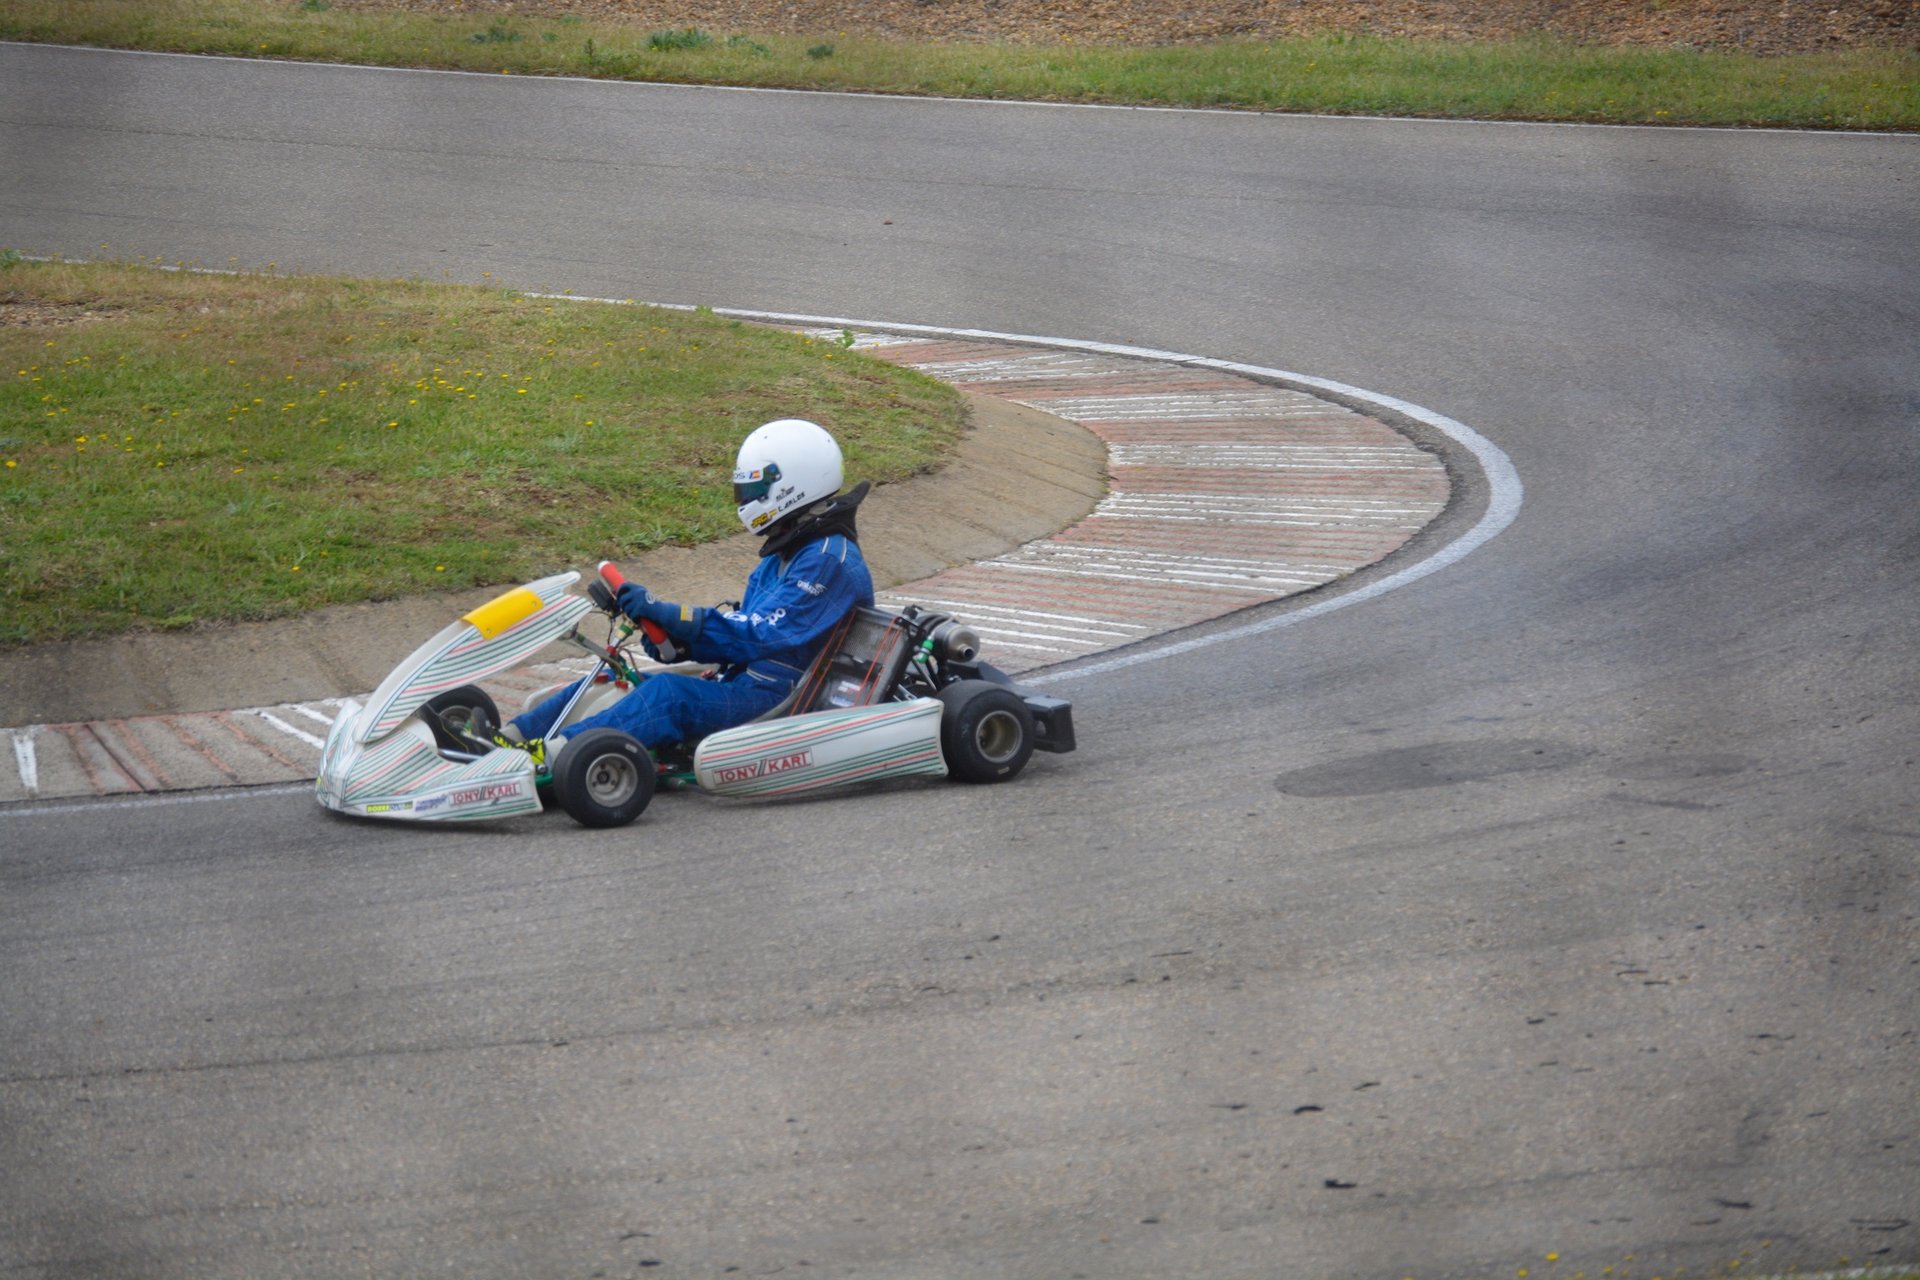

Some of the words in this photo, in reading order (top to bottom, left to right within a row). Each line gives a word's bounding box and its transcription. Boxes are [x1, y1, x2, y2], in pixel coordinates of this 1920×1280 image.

[714, 764, 758, 783] TONY
[766, 751, 810, 773] KART
[452, 789, 480, 804] TONY
[485, 783, 520, 799] KART
